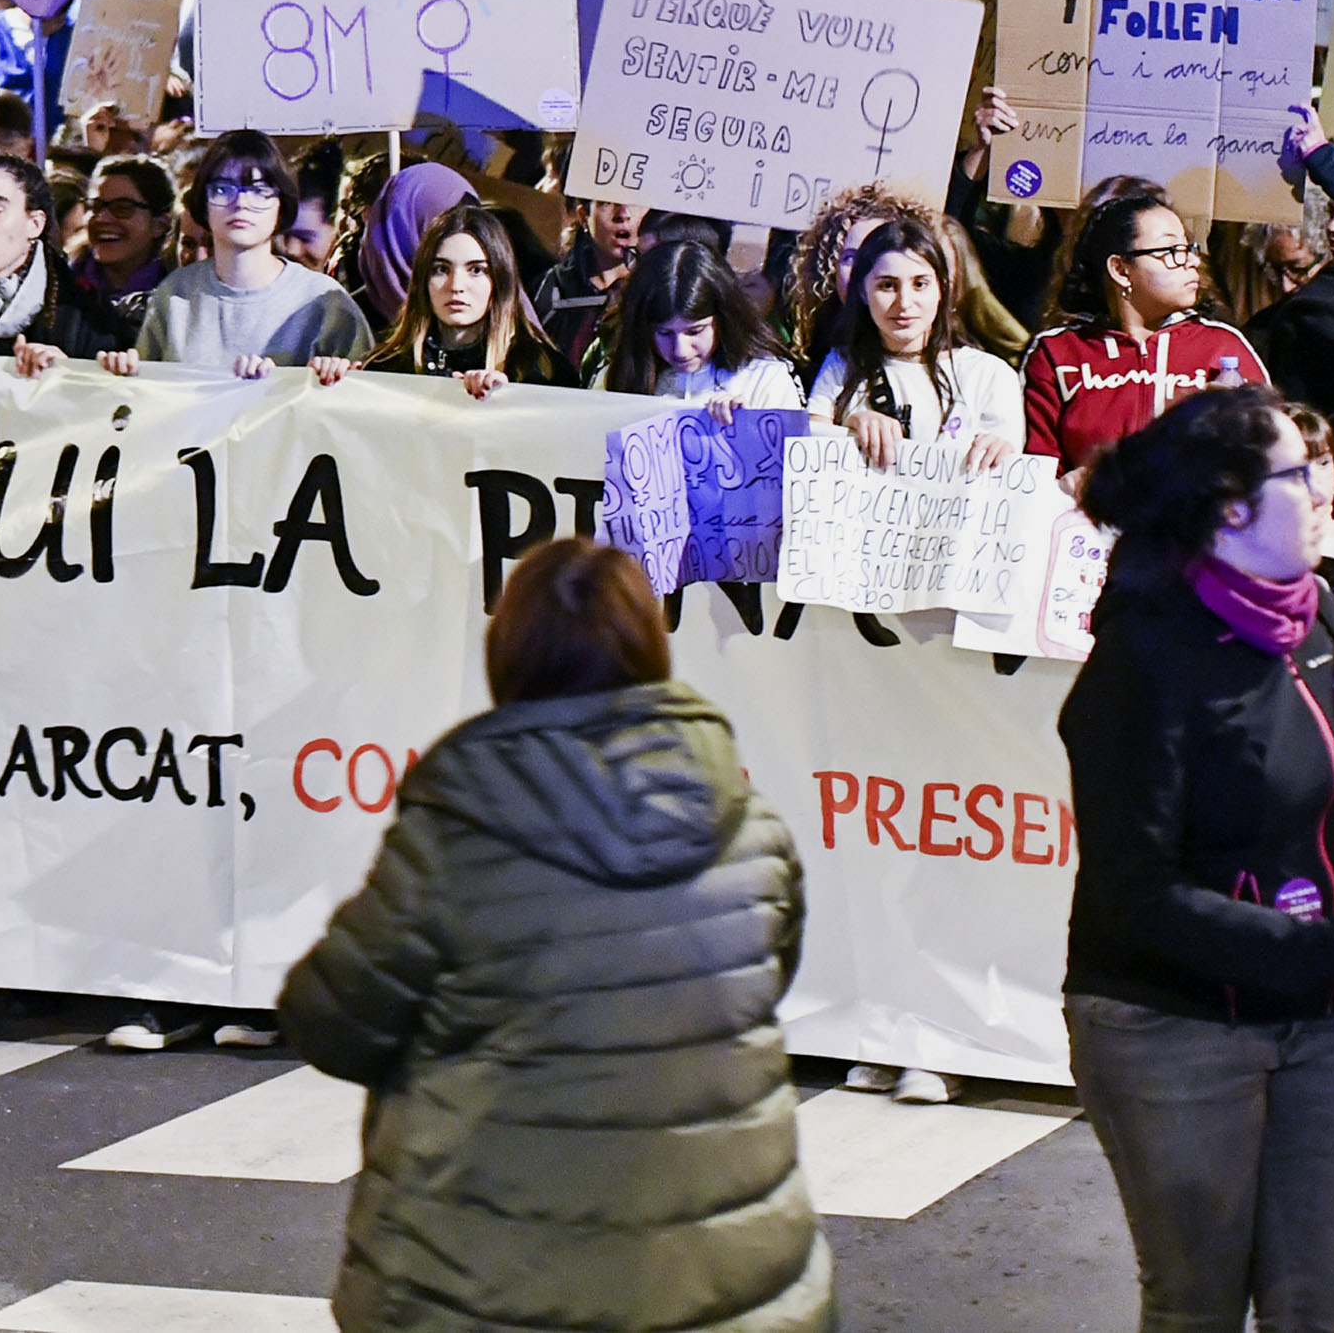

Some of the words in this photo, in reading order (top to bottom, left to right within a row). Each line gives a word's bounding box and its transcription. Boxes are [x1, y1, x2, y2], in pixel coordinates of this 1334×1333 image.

[260, 0, 373, 101] 8M
[797, 8, 896, 54] VULL
[1239, 67, 1290, 96] qui
[646, 104, 792, 154] SEGURA
[1089, 122, 1153, 147] dona
[1163, 123, 1188, 147] la
[1207, 133, 1283, 164] gana
[594, 148, 650, 190] DE
[178, 445, 381, 597] LA
[790, 479, 820, 515] DE
[979, 498, 1011, 536] LA
[786, 548, 817, 576] EL
[992, 541, 1026, 563] NO
[292, 737, 420, 814] CO
